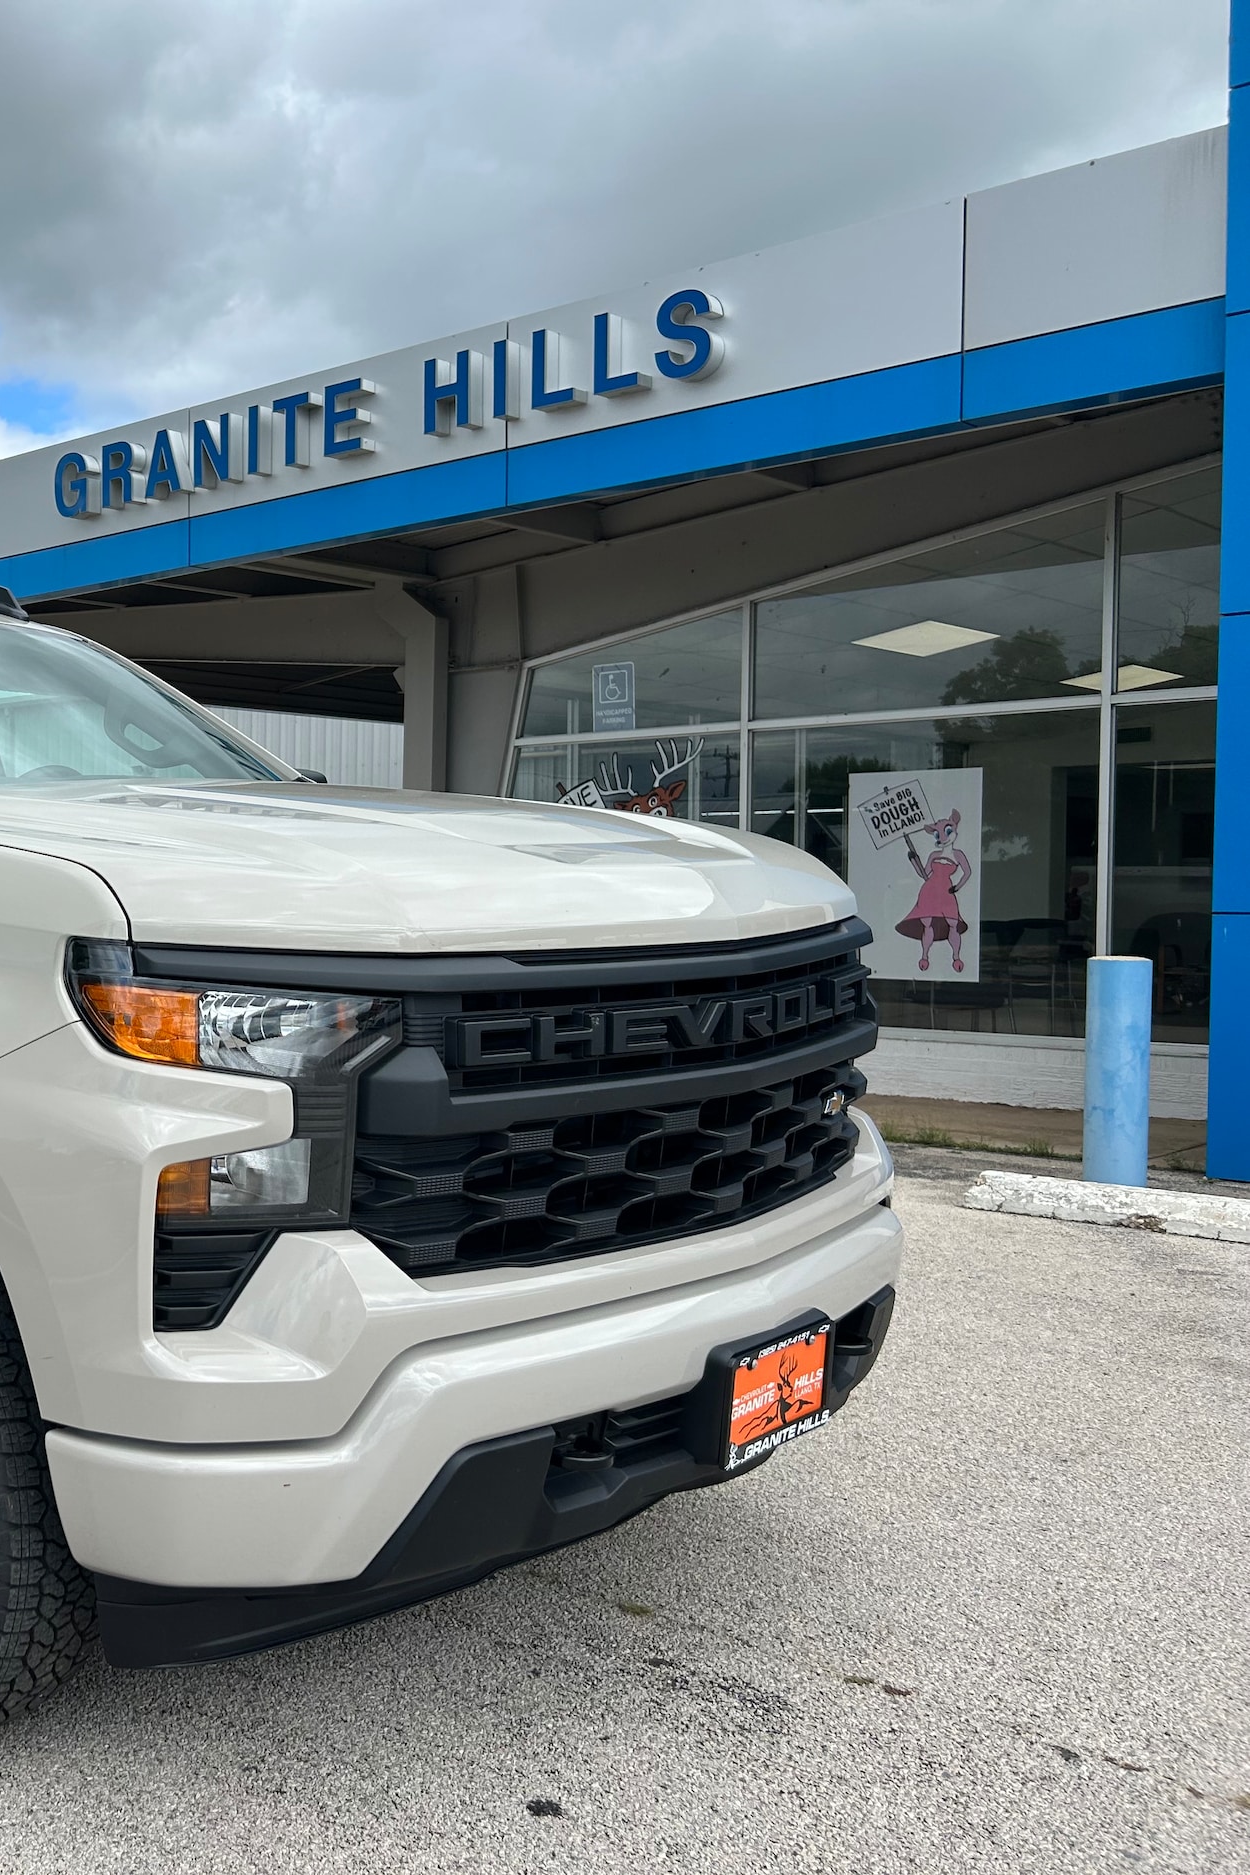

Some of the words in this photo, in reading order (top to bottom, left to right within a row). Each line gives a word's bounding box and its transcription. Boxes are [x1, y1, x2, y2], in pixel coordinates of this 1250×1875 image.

[55, 378, 372, 519] GRANITE
[424, 289, 722, 437] HILLS
[596, 708, 632, 717] HANDICAPPED
[871, 797, 920, 829] DOUGH
[873, 798, 896, 812] Save
[896, 788, 912, 801] BIG
[889, 811, 925, 833] LLANO!
[457, 965, 871, 1066] CHEVROLET
[732, 1389, 775, 1420] GRANITE
[794, 1367, 823, 1390] HILLS
[741, 1384, 767, 1402] CHEVROLET
[814, 1380, 821, 1389] TX
[744, 1425, 797, 1459] GRANITE
[796, 1409, 830, 1435] HILLS
